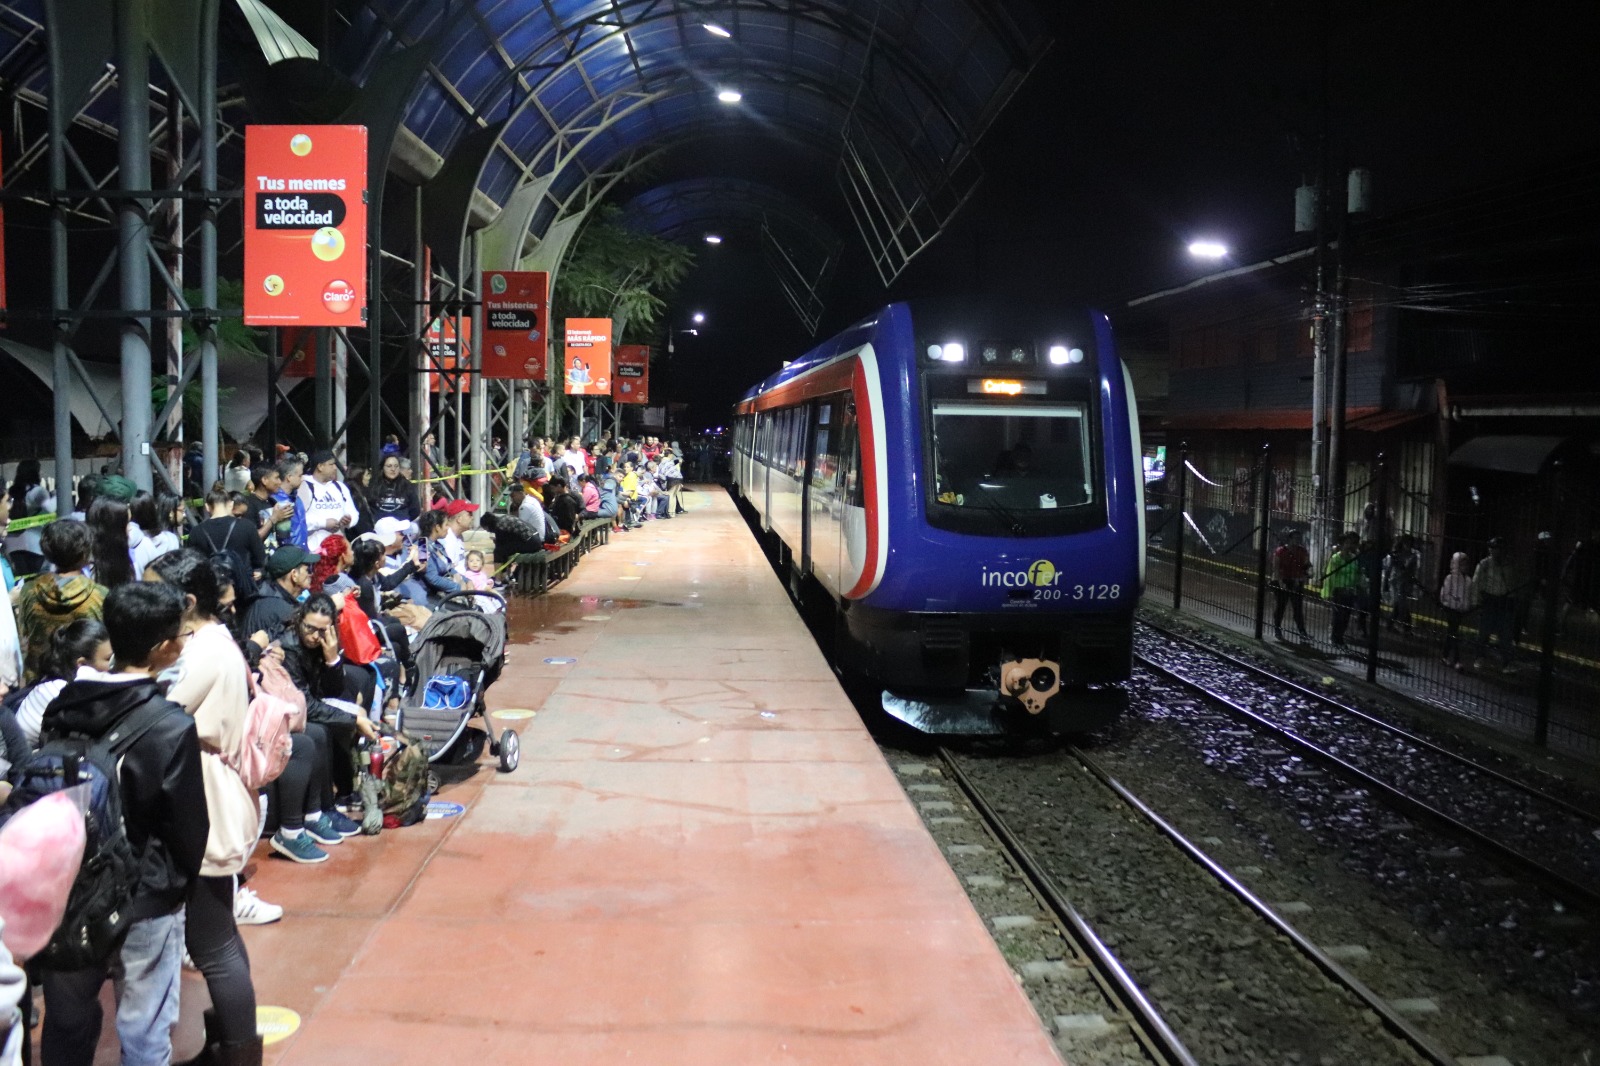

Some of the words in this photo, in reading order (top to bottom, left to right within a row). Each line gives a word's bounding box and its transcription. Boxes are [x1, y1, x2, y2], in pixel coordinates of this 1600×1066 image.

[257, 176, 285, 190] Tus
[288, 178, 346, 190] memes
[264, 199, 273, 210] a
[275, 196, 308, 210] toda
[264, 210, 333, 225] velocidad
[323, 291, 350, 302] Claro
[487, 301, 501, 309] Tus
[502, 301, 538, 310] historias
[497, 311, 517, 320] toda
[491, 319, 530, 328] velocidad
[315, 502, 342, 510] adidas
[982, 560, 1063, 587] incofer
